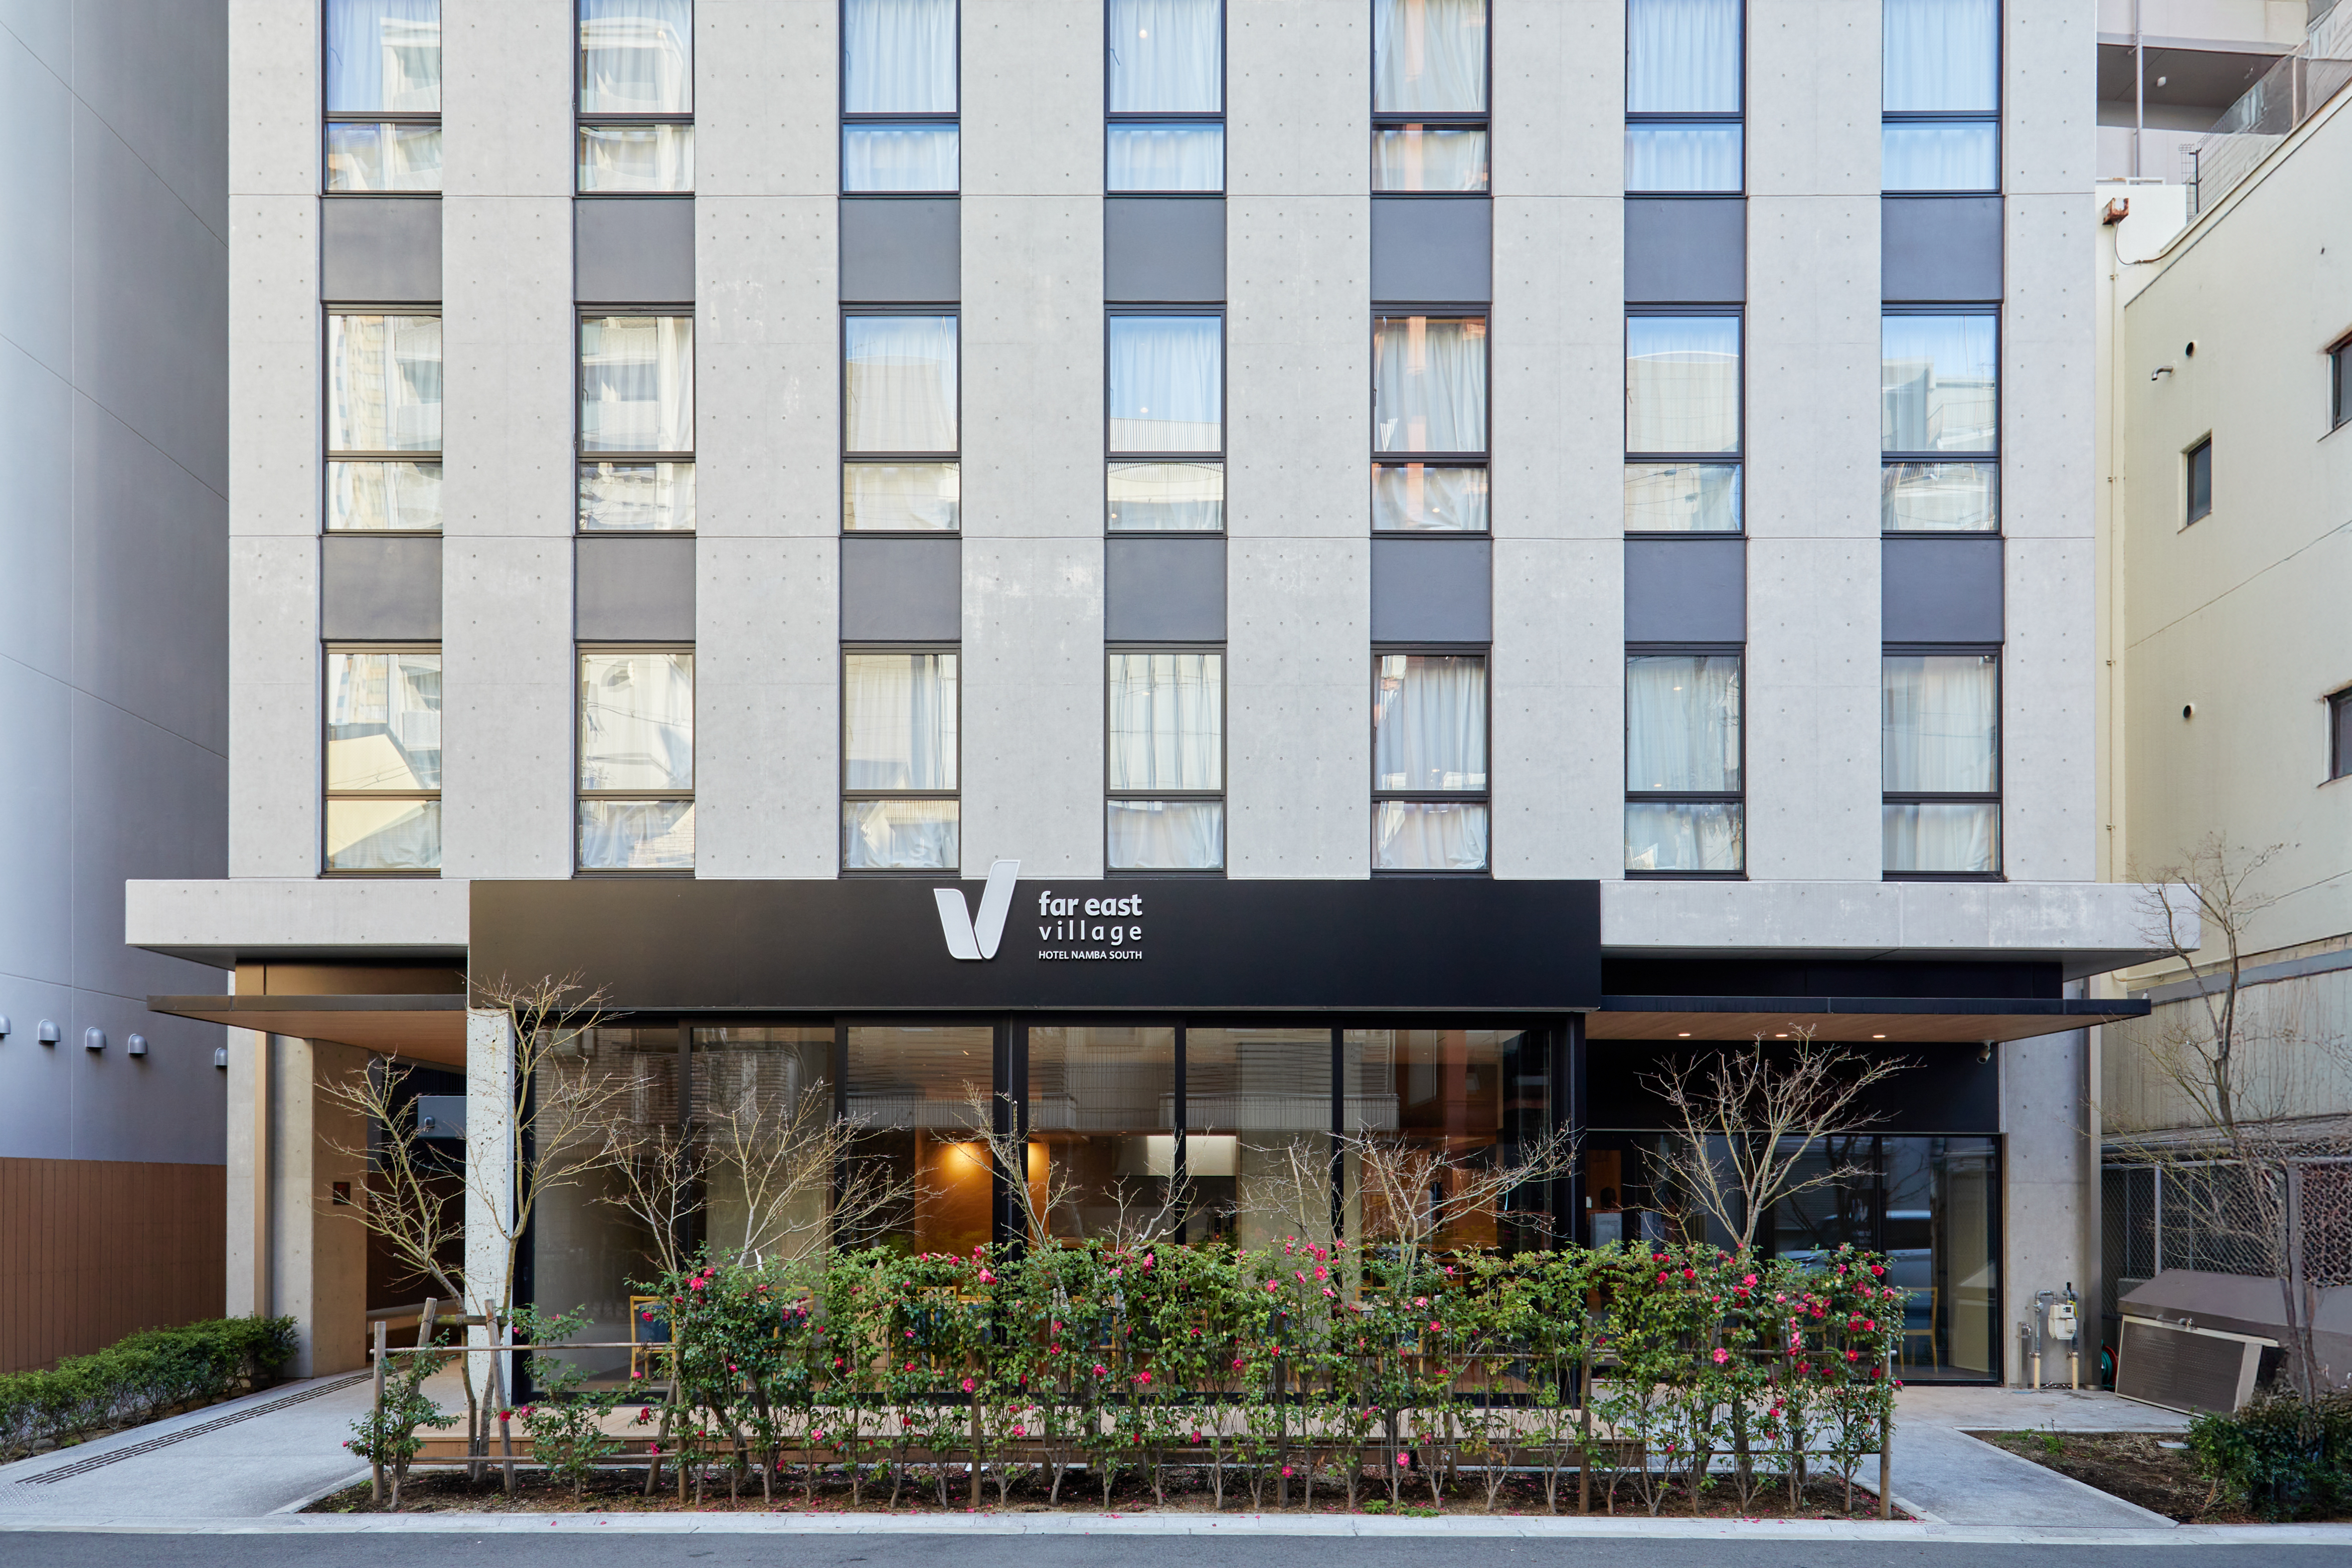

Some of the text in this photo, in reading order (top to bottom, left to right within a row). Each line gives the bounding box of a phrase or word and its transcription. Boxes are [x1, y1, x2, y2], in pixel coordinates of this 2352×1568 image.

[1039, 890, 1143, 916] far east
[1039, 920, 1142, 946] village
[1039, 951, 1142, 960] HOTEL NAMBA SOUTH
